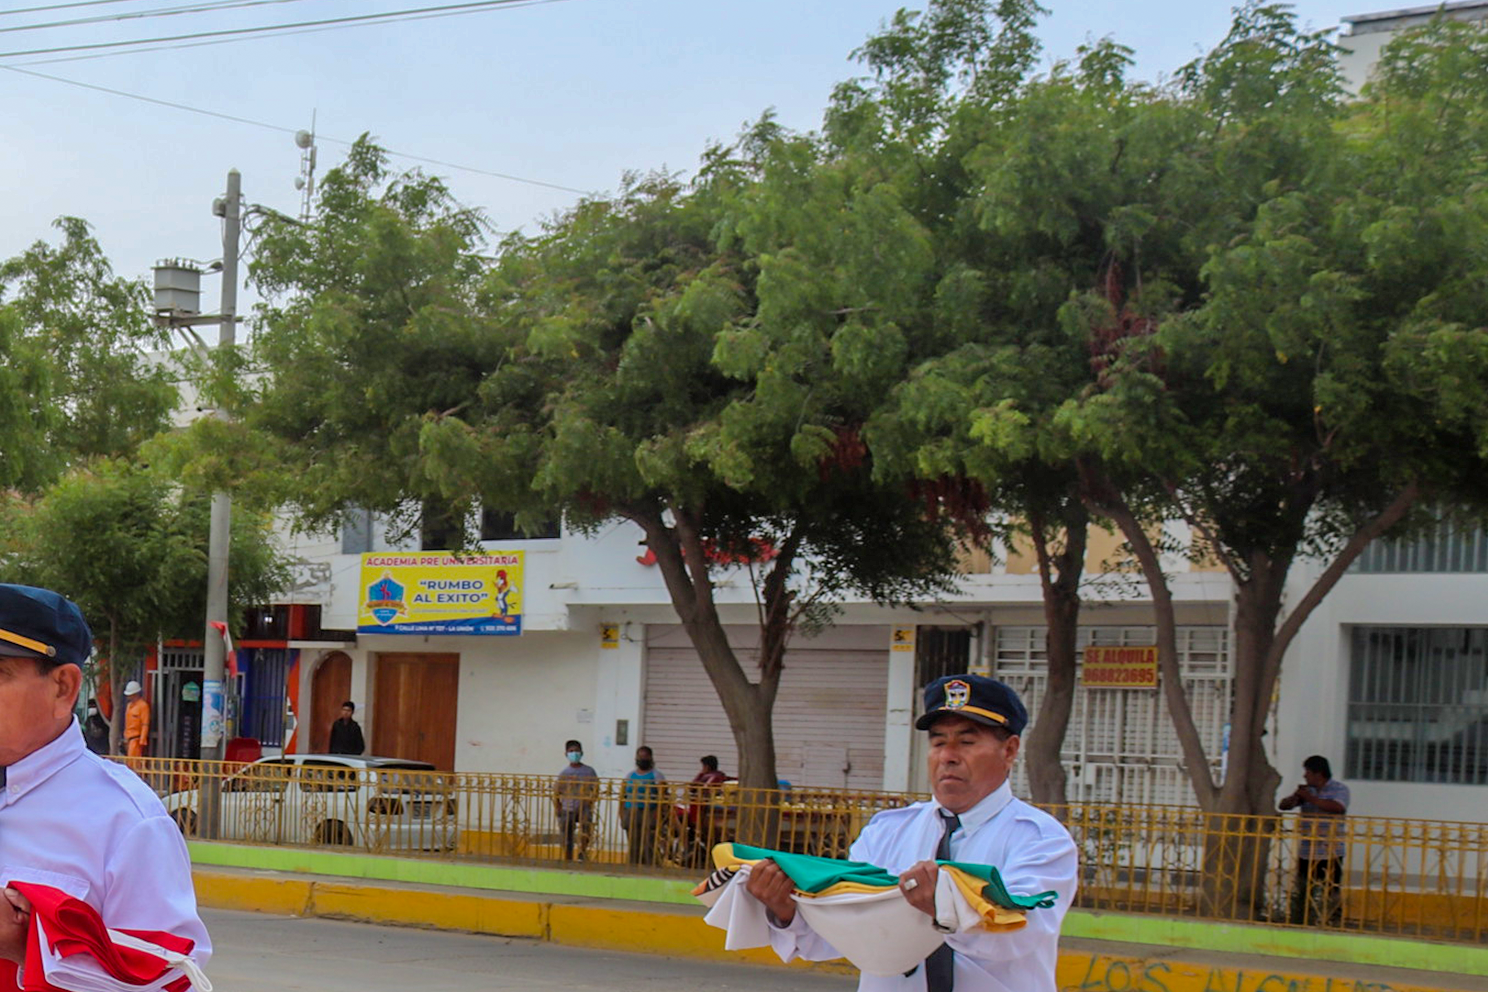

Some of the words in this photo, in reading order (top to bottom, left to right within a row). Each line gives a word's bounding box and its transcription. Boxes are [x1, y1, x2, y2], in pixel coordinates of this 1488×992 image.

[366, 557, 418, 566] ACADEMIA
[420, 556, 440, 566] PRE
[414, 594, 432, 603] AL
[1086, 649, 1100, 663] SE
[1102, 649, 1155, 665] ALQUILA
